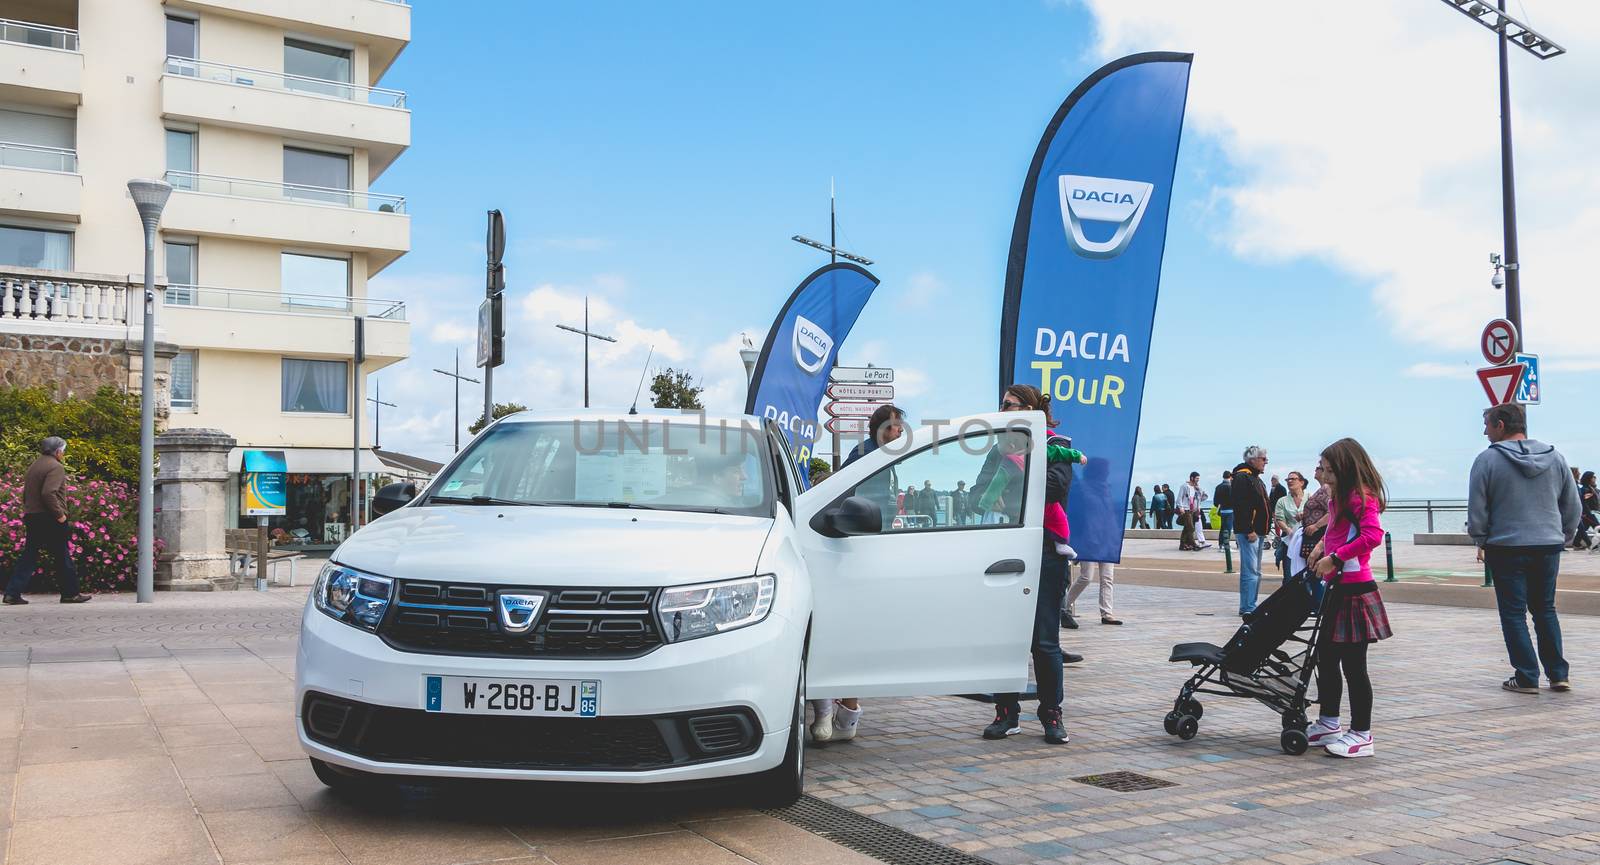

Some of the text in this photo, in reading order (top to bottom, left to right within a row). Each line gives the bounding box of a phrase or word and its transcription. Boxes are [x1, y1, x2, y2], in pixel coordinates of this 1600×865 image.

[1072, 188, 1135, 205] DACIA
[801, 326, 827, 350] DACIA
[1034, 327, 1131, 363] DACIA
[864, 370, 889, 379] Le Port
[764, 405, 815, 440] DACIA
[431, 682, 596, 713] F W-268-BJ 85
